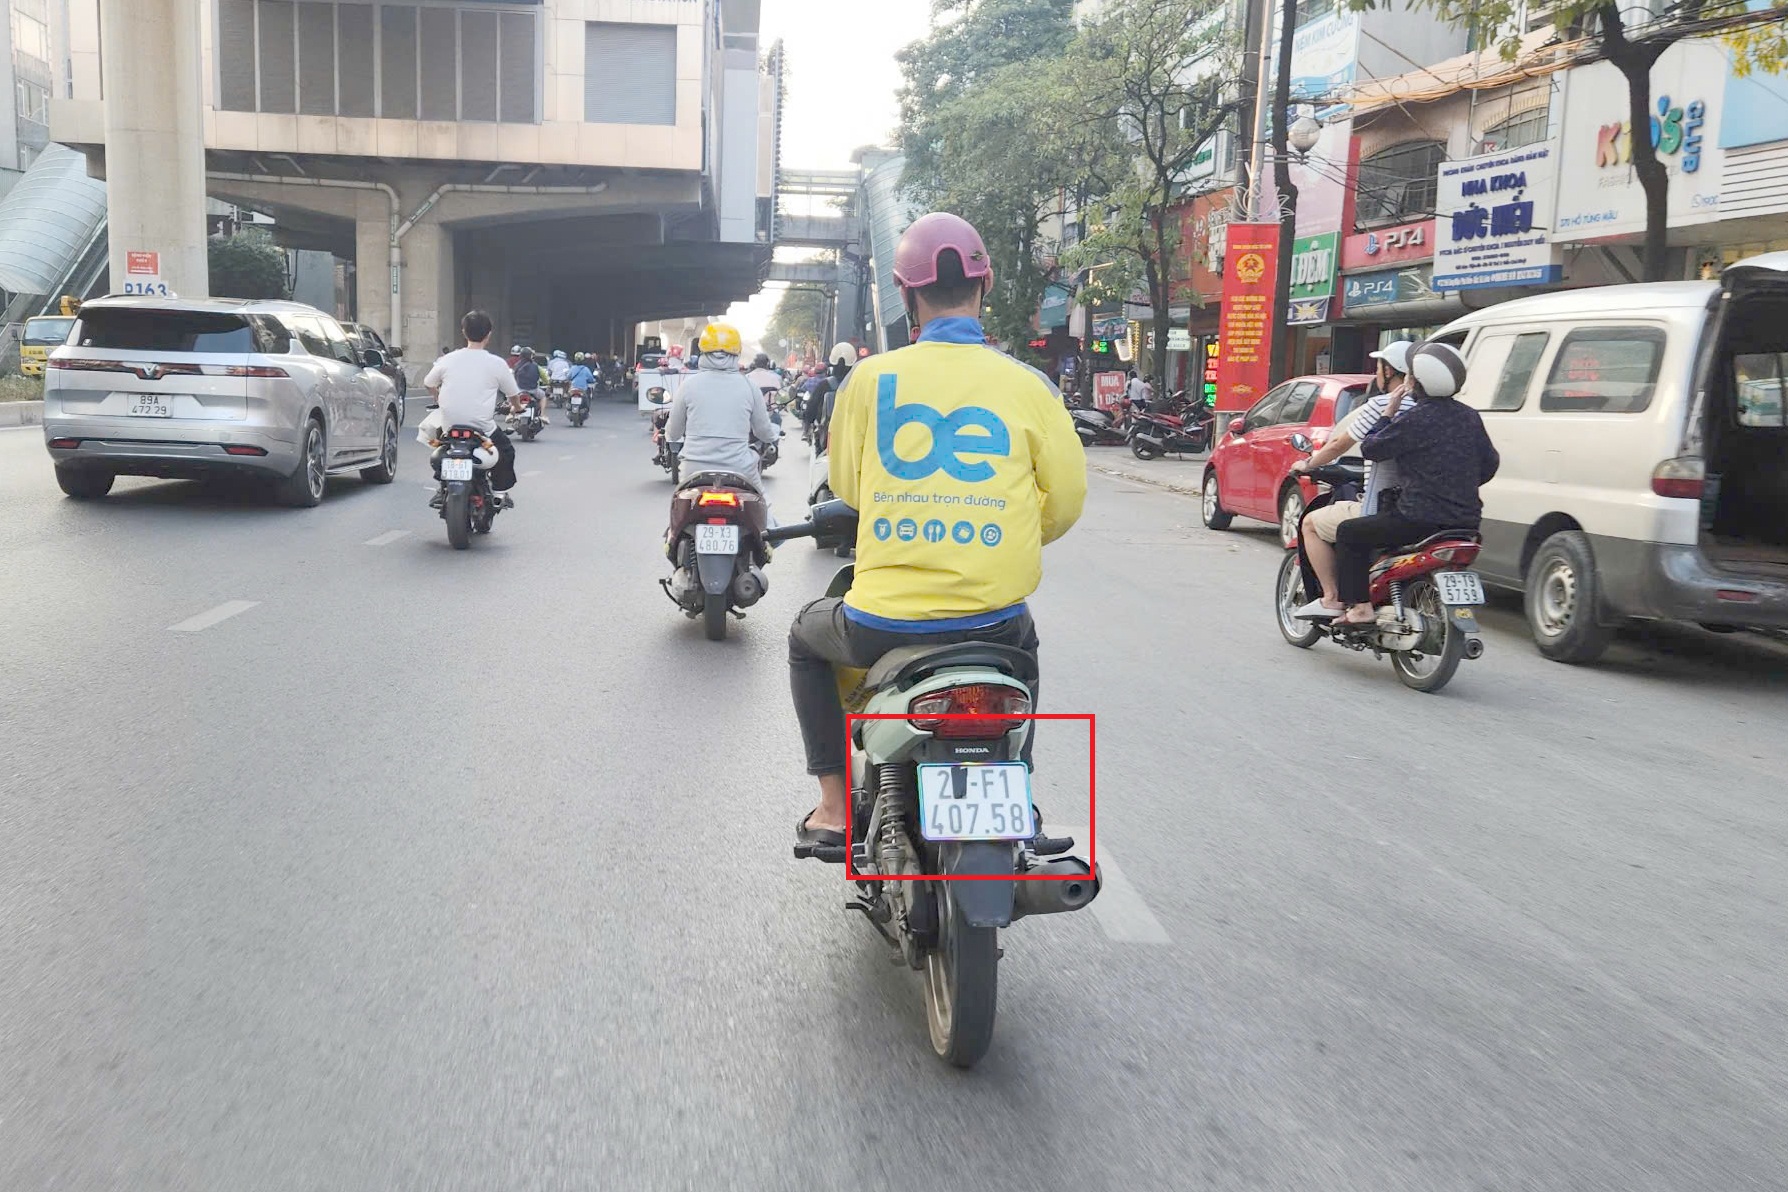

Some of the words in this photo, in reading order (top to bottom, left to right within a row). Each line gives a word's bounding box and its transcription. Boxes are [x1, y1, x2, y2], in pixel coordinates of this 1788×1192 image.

[1681, 100, 1705, 174] CLUB
[1490, 171, 1527, 192] KHOA
[1384, 227, 1424, 251] PS4
[1364, 280, 1393, 294] PS4
[140, 395, 159, 405] 89A
[876, 374, 1010, 483] be
[873, 491, 893, 503] Bên
[897, 491, 929, 503] nhau
[933, 493, 960, 507] trọn
[964, 495, 1006, 511] đường
[703, 526, 731, 538] 29-X3
[699, 540, 735, 552] 480.76
[1444, 575, 1476, 588] 29-T9
[937, 767, 1010, 800] 2-F1
[931, 803, 1025, 835] 407.58
